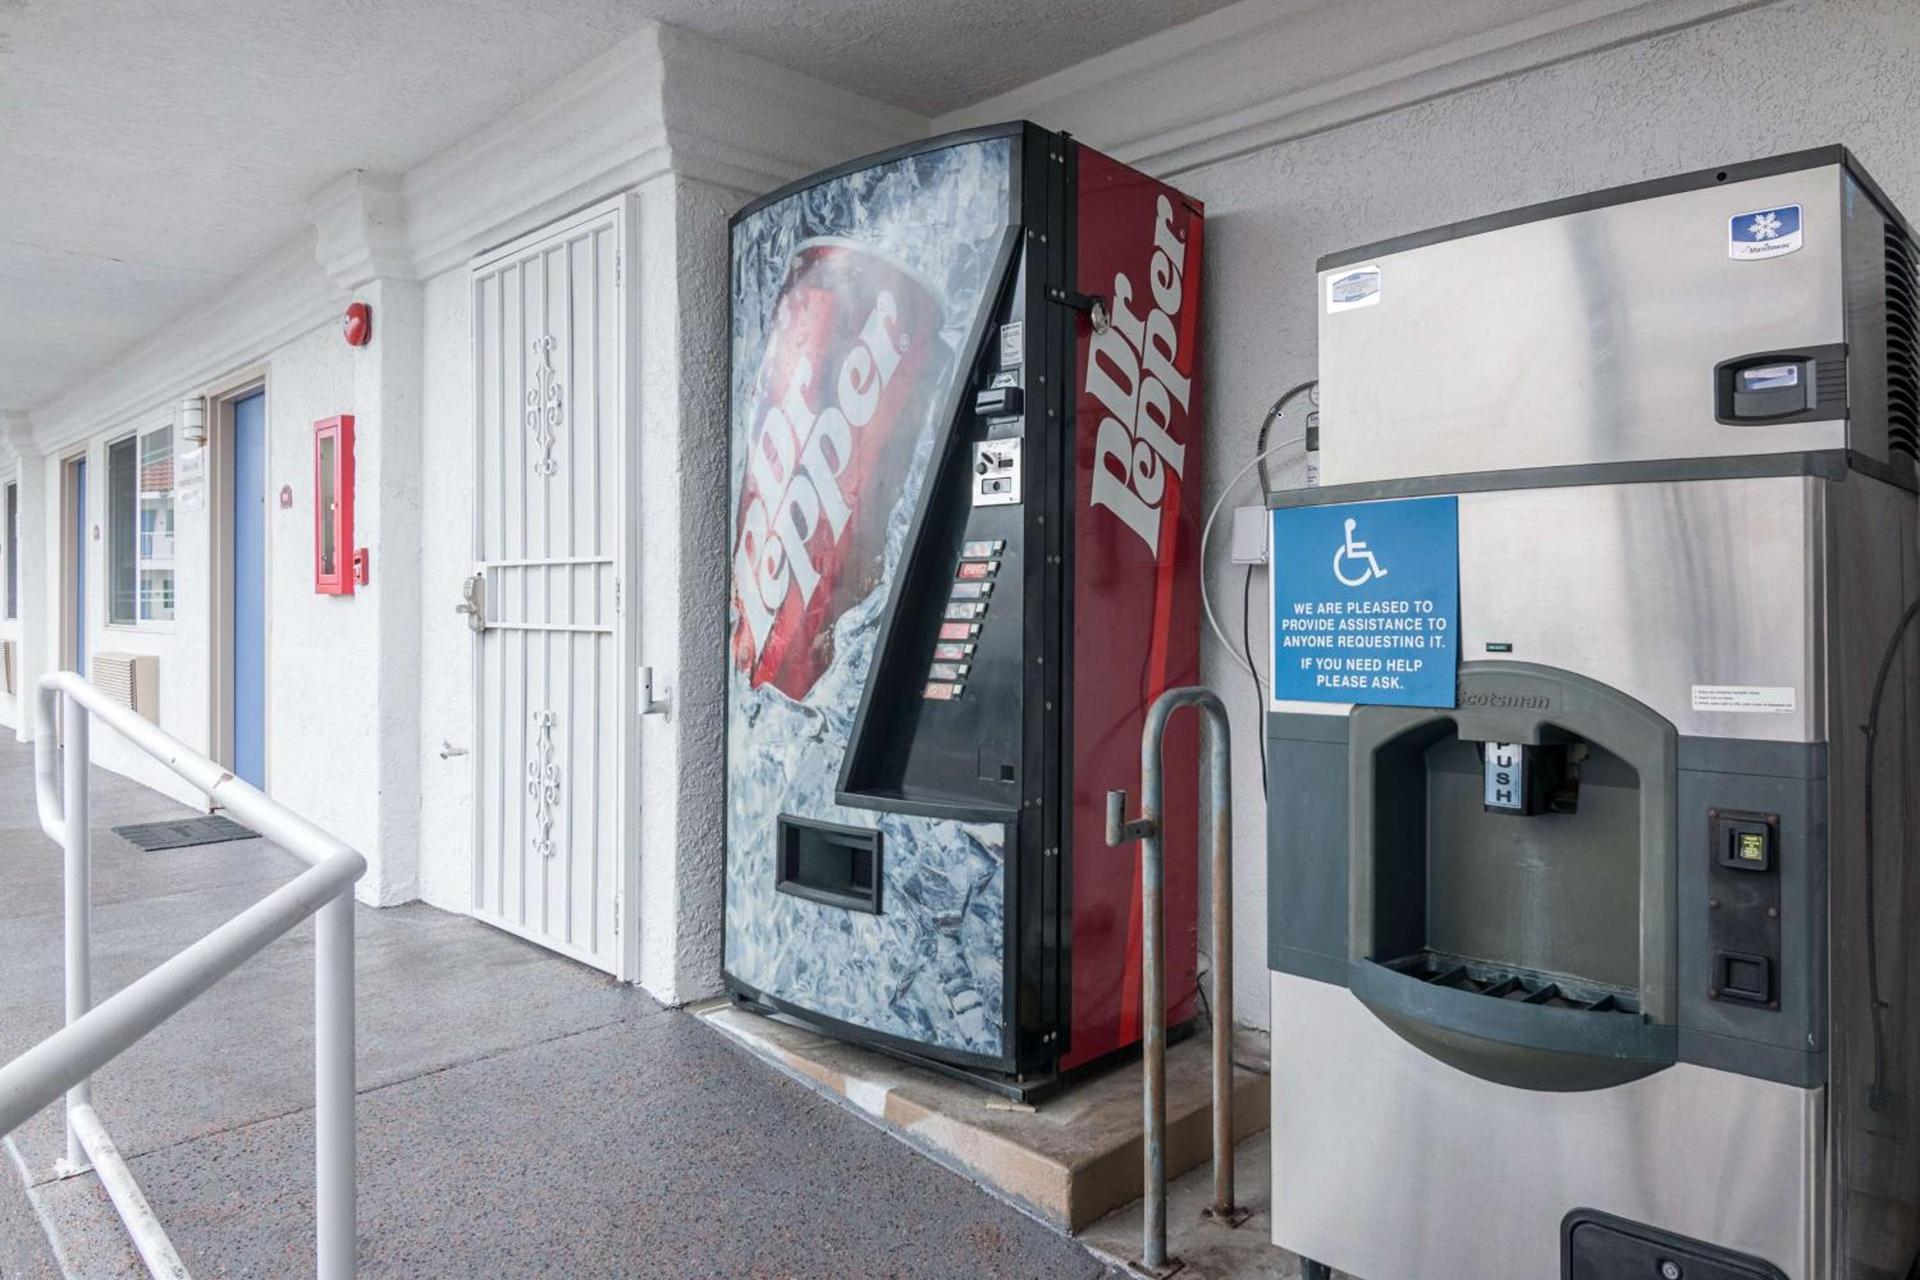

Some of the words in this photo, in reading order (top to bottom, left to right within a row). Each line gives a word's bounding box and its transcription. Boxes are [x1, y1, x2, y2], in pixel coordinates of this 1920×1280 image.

[1085, 272, 1146, 439] Dr
[1090, 194, 1192, 560] Pepper
[752, 353, 817, 532] Dr
[734, 290, 901, 661] Pepper
[1294, 602, 1313, 615] WE
[1317, 602, 1343, 614] ARE
[1347, 600, 1409, 614] PLEASED
[1413, 600, 1433, 613] TO
[1282, 618, 1335, 631] PROVIDE
[1338, 617, 1423, 631] ASSISTANCE
[1427, 617, 1447, 631] TO
[1283, 635, 1334, 648] ANYONE
[1337, 635, 1425, 649] REQUESTING
[1429, 635, 1446, 648] IT.
[1301, 657, 1312, 669] IF
[1315, 657, 1342, 671] YOU
[1346, 658, 1382, 672] NEED
[1386, 658, 1423, 672] HELP
[1316, 674, 1367, 688] PLEASE
[1371, 676, 1404, 689] ASK.
